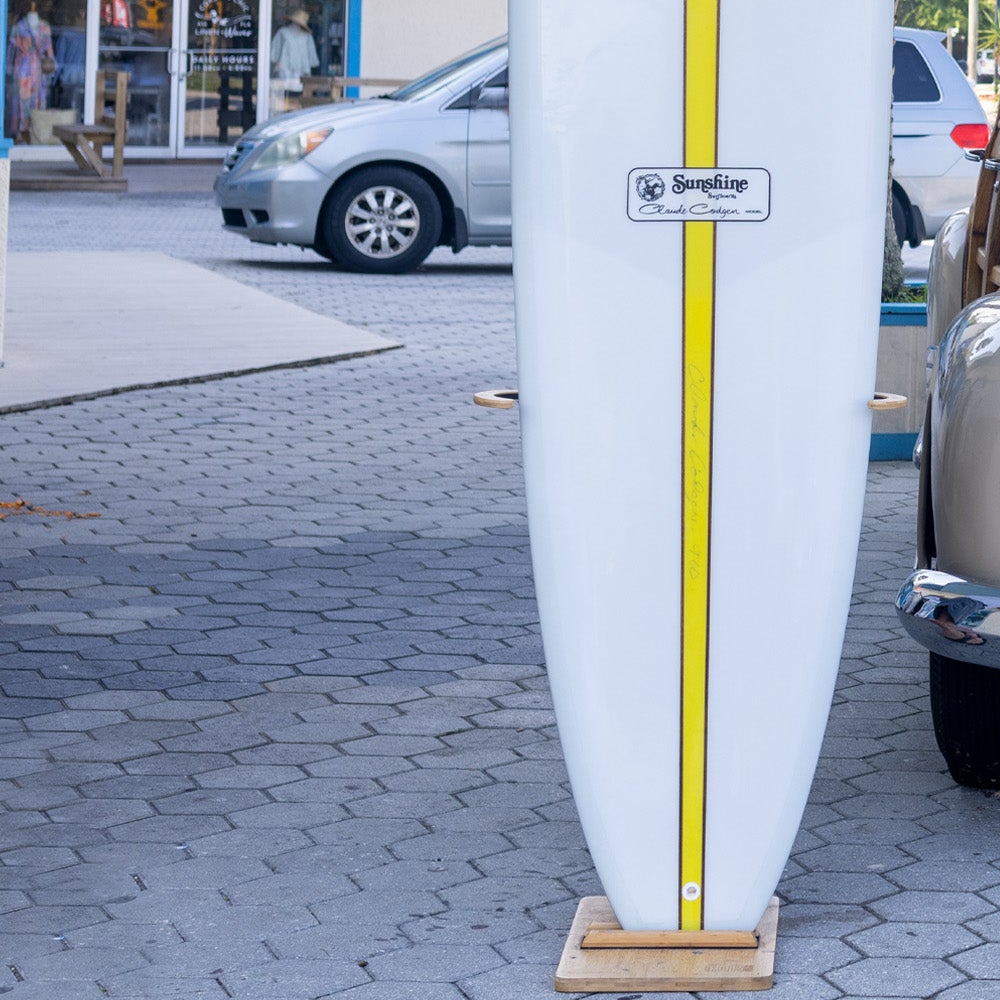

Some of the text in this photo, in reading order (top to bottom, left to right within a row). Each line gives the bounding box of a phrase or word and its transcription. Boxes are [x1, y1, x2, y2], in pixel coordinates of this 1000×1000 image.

[221, 54, 255, 64] HOURS
[672, 173, 749, 194] Sunshine
[638, 203, 687, 215] Claude
